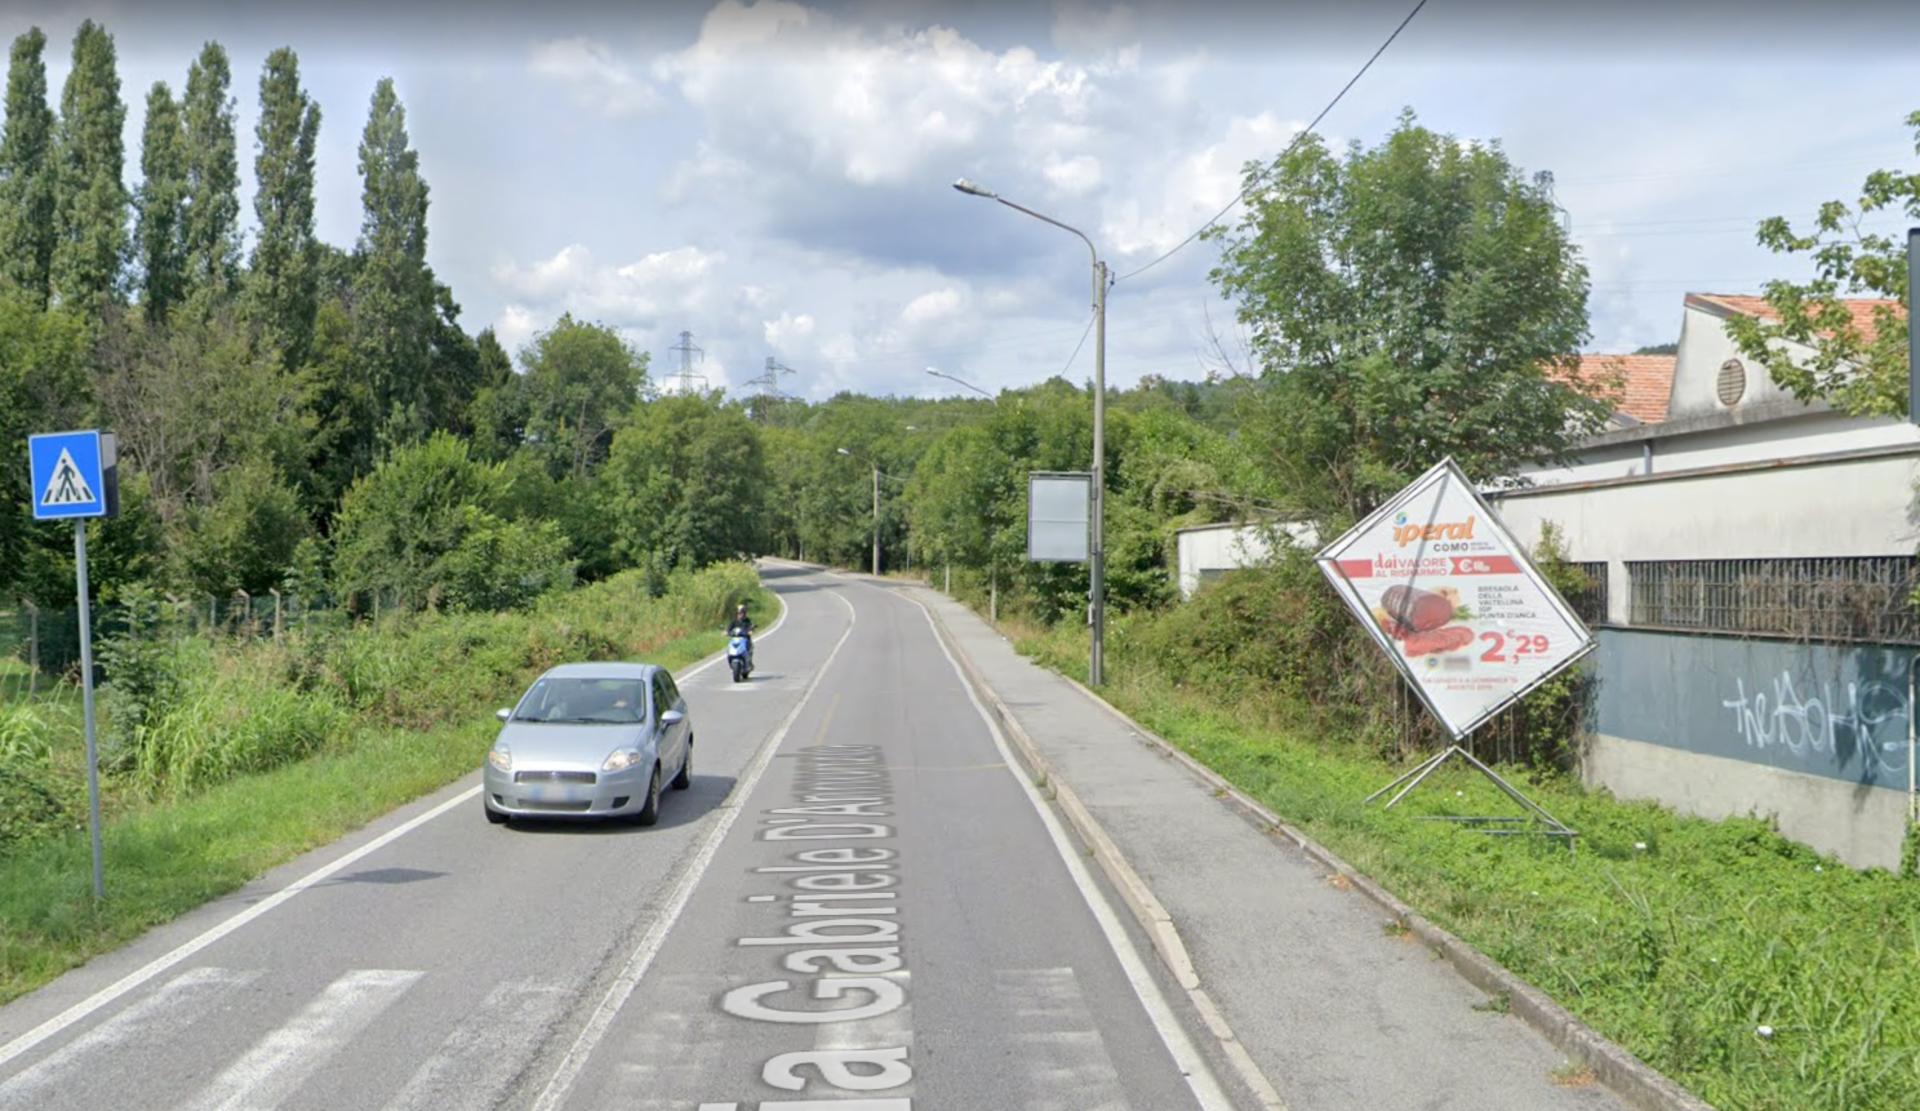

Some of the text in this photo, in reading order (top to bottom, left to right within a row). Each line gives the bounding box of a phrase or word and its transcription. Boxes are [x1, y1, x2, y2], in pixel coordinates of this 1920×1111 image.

[1393, 511, 1475, 548] iperal
[1433, 542, 1469, 552] COMO
[1399, 558, 1447, 568] VALORE
[1391, 568, 1447, 577] RISPARMIO
